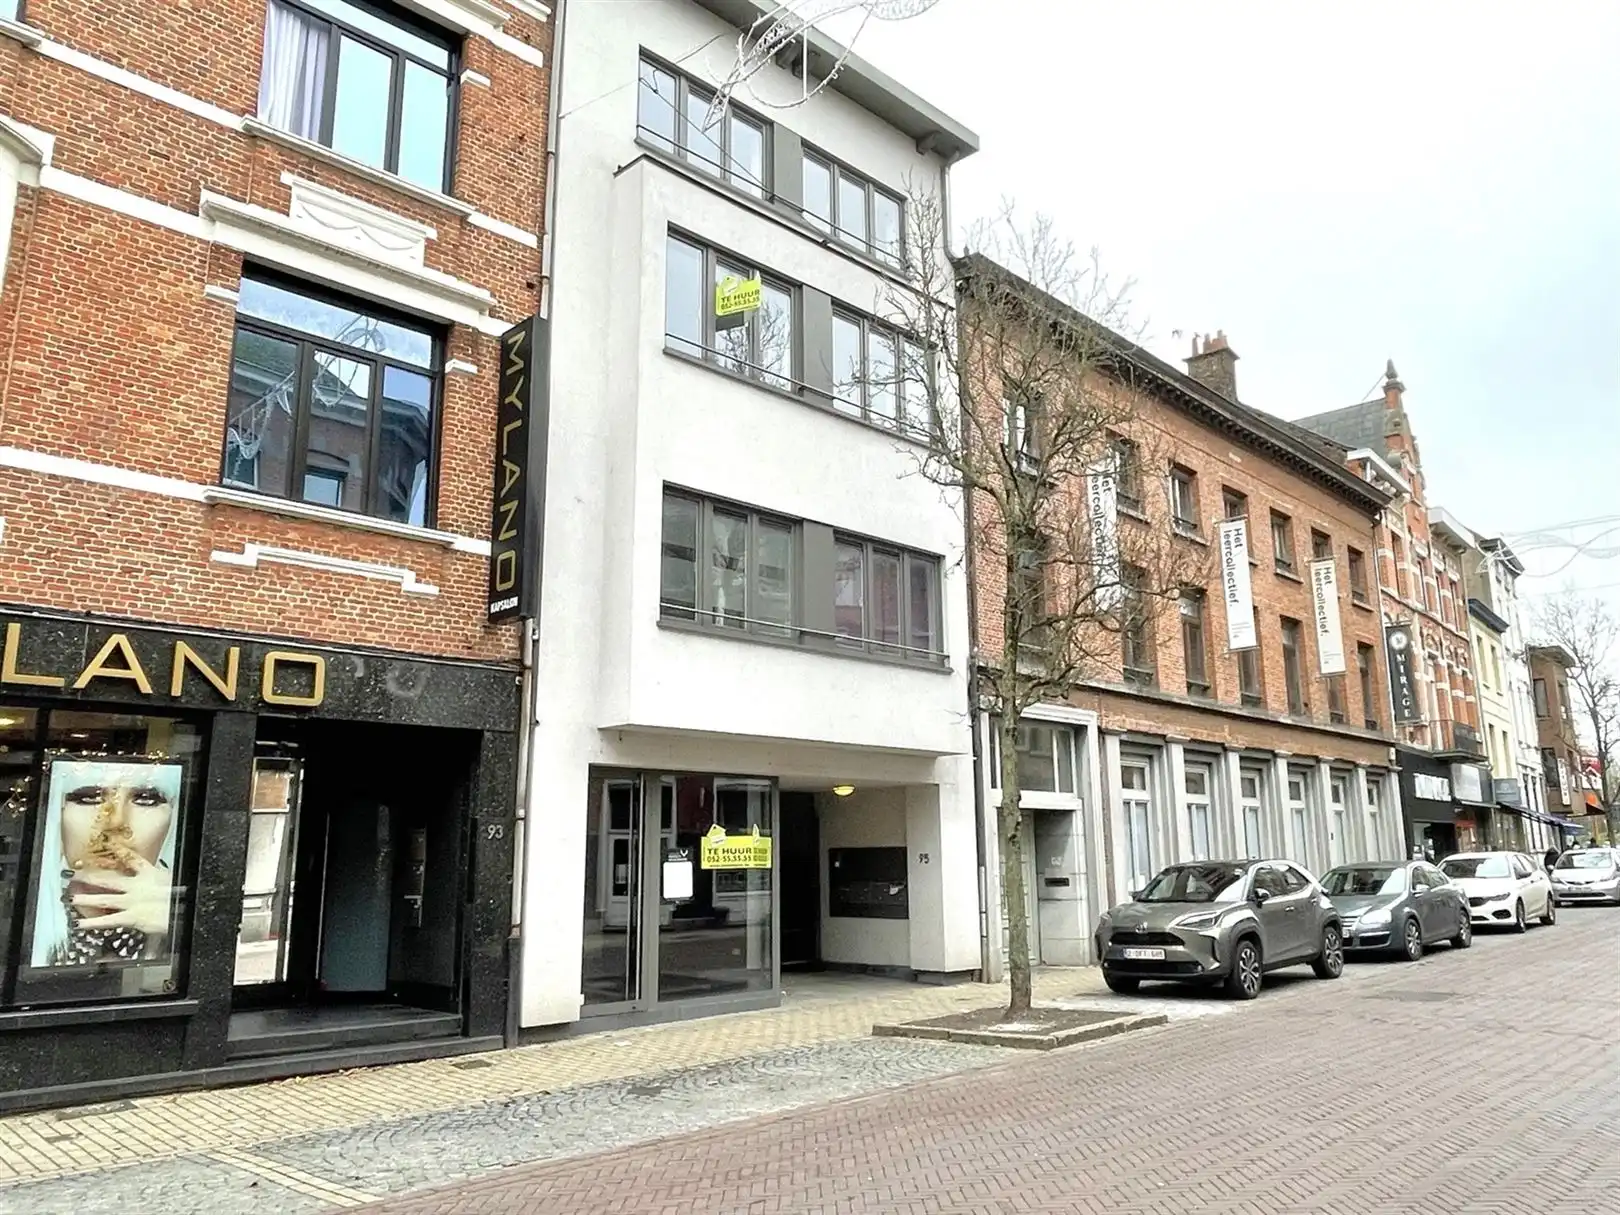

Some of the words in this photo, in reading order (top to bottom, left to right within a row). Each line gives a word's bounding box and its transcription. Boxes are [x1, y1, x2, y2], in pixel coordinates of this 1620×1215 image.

[734, 289, 760, 301] HUUR
[496, 331, 526, 592] MYLANO
[1233, 528, 1243, 548] Het
[1323, 567, 1333, 585] Het
[1, 622, 326, 708] LANO
[1395, 654, 1411, 718] MIRAGE
[488, 824, 504, 840] 93
[707, 848, 719, 856] TE
[722, 847, 752, 855] HUUR
[919, 853, 930, 864] 95
